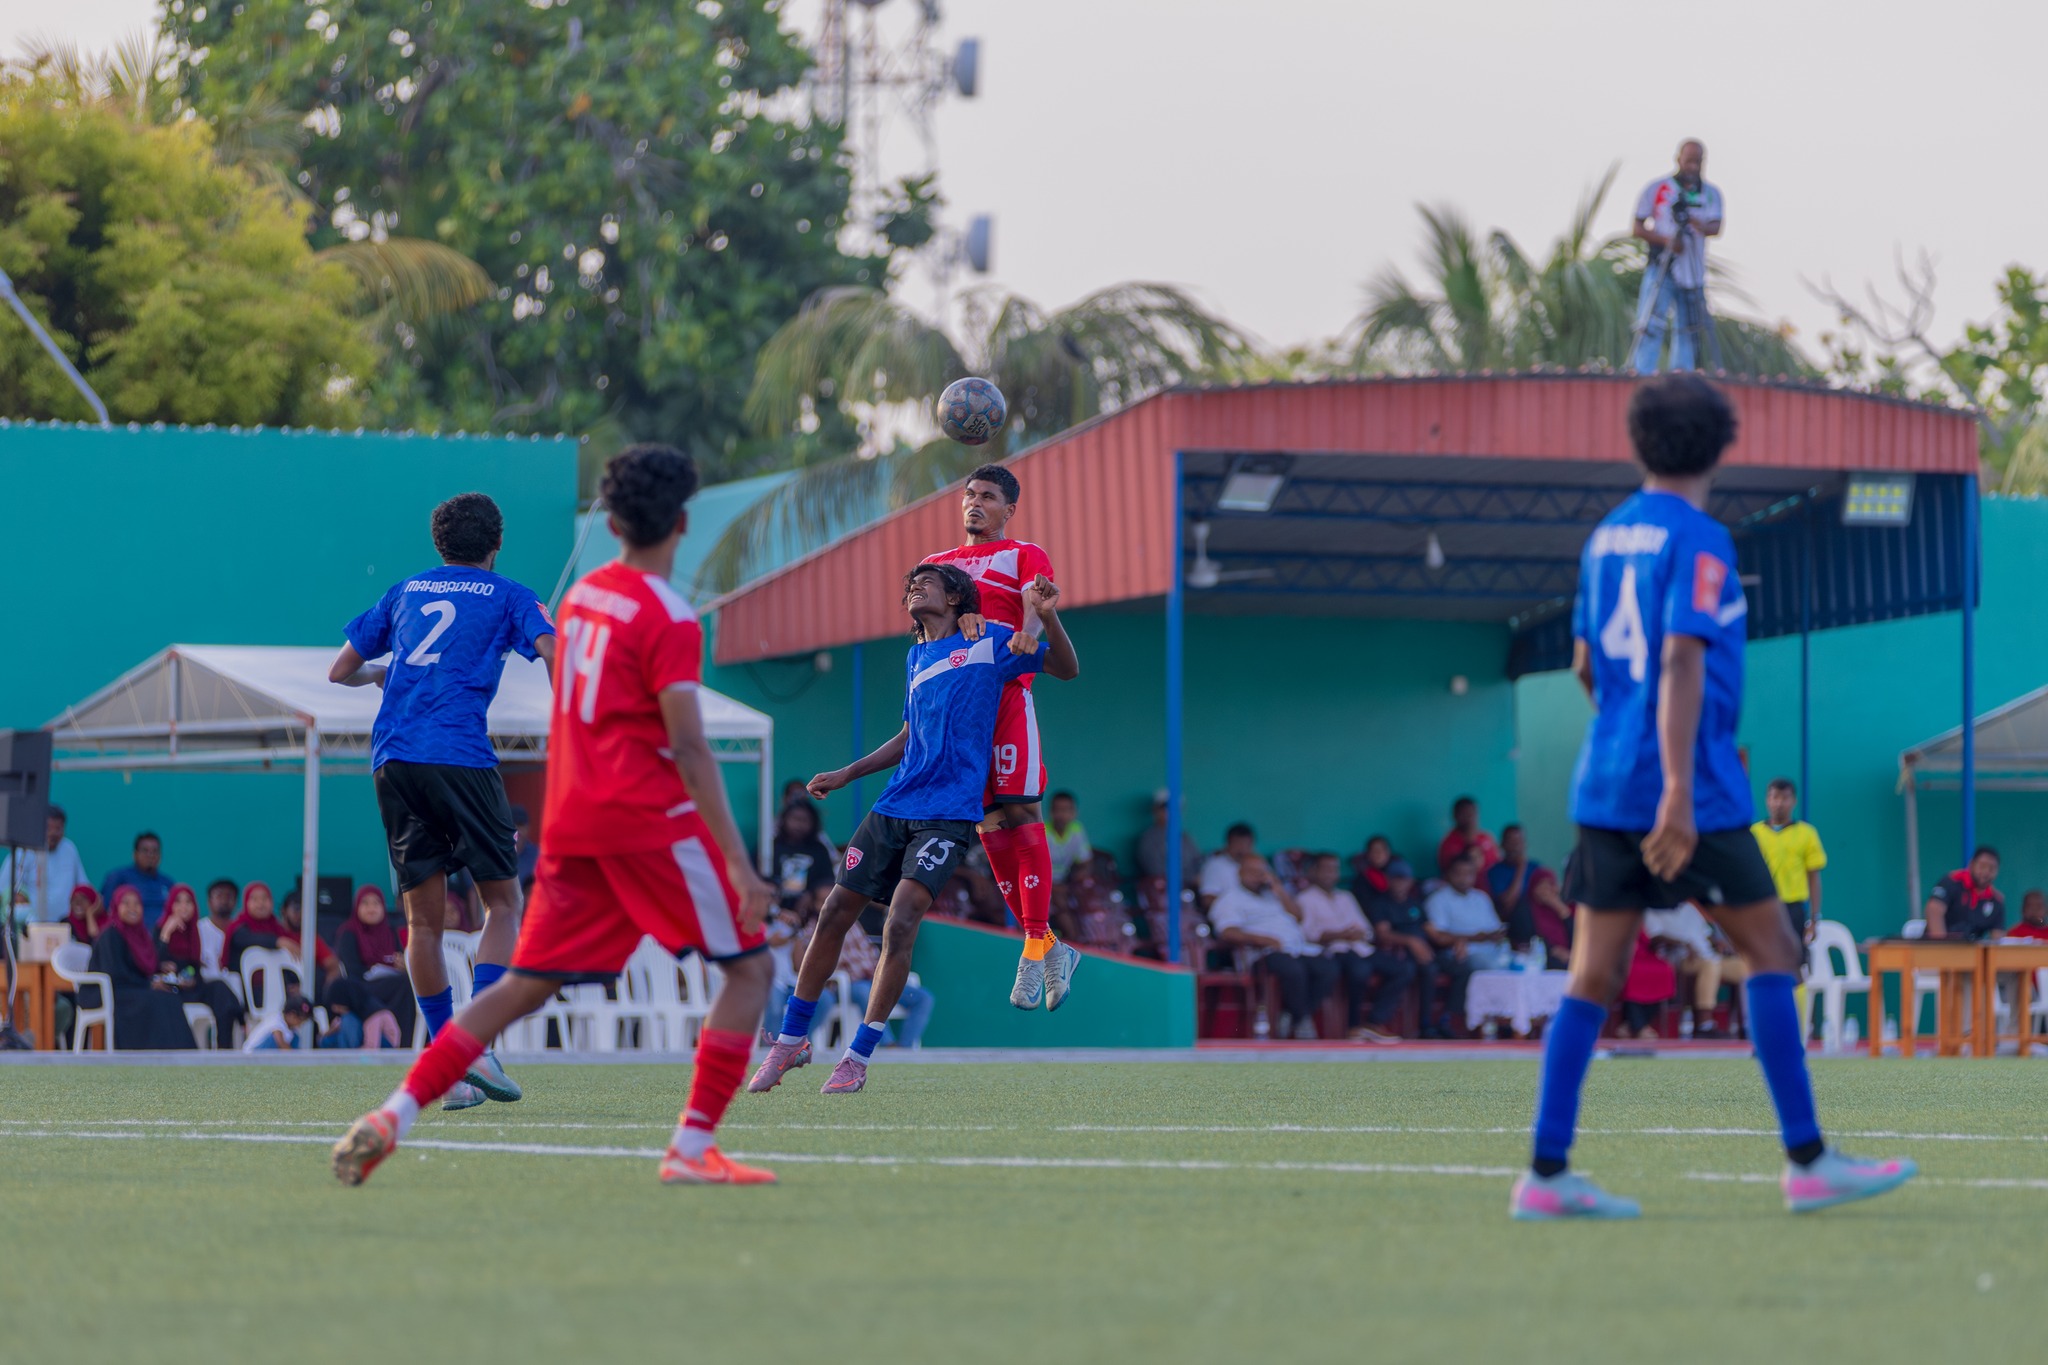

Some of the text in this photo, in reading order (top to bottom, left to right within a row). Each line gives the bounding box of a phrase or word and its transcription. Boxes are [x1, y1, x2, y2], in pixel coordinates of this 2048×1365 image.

[404, 580, 495, 596] MAHIBADHOO
[405, 599, 457, 667] 2
[1600, 563, 1649, 684] 4
[563, 615, 611, 724] 14
[993, 743, 1018, 775] 19
